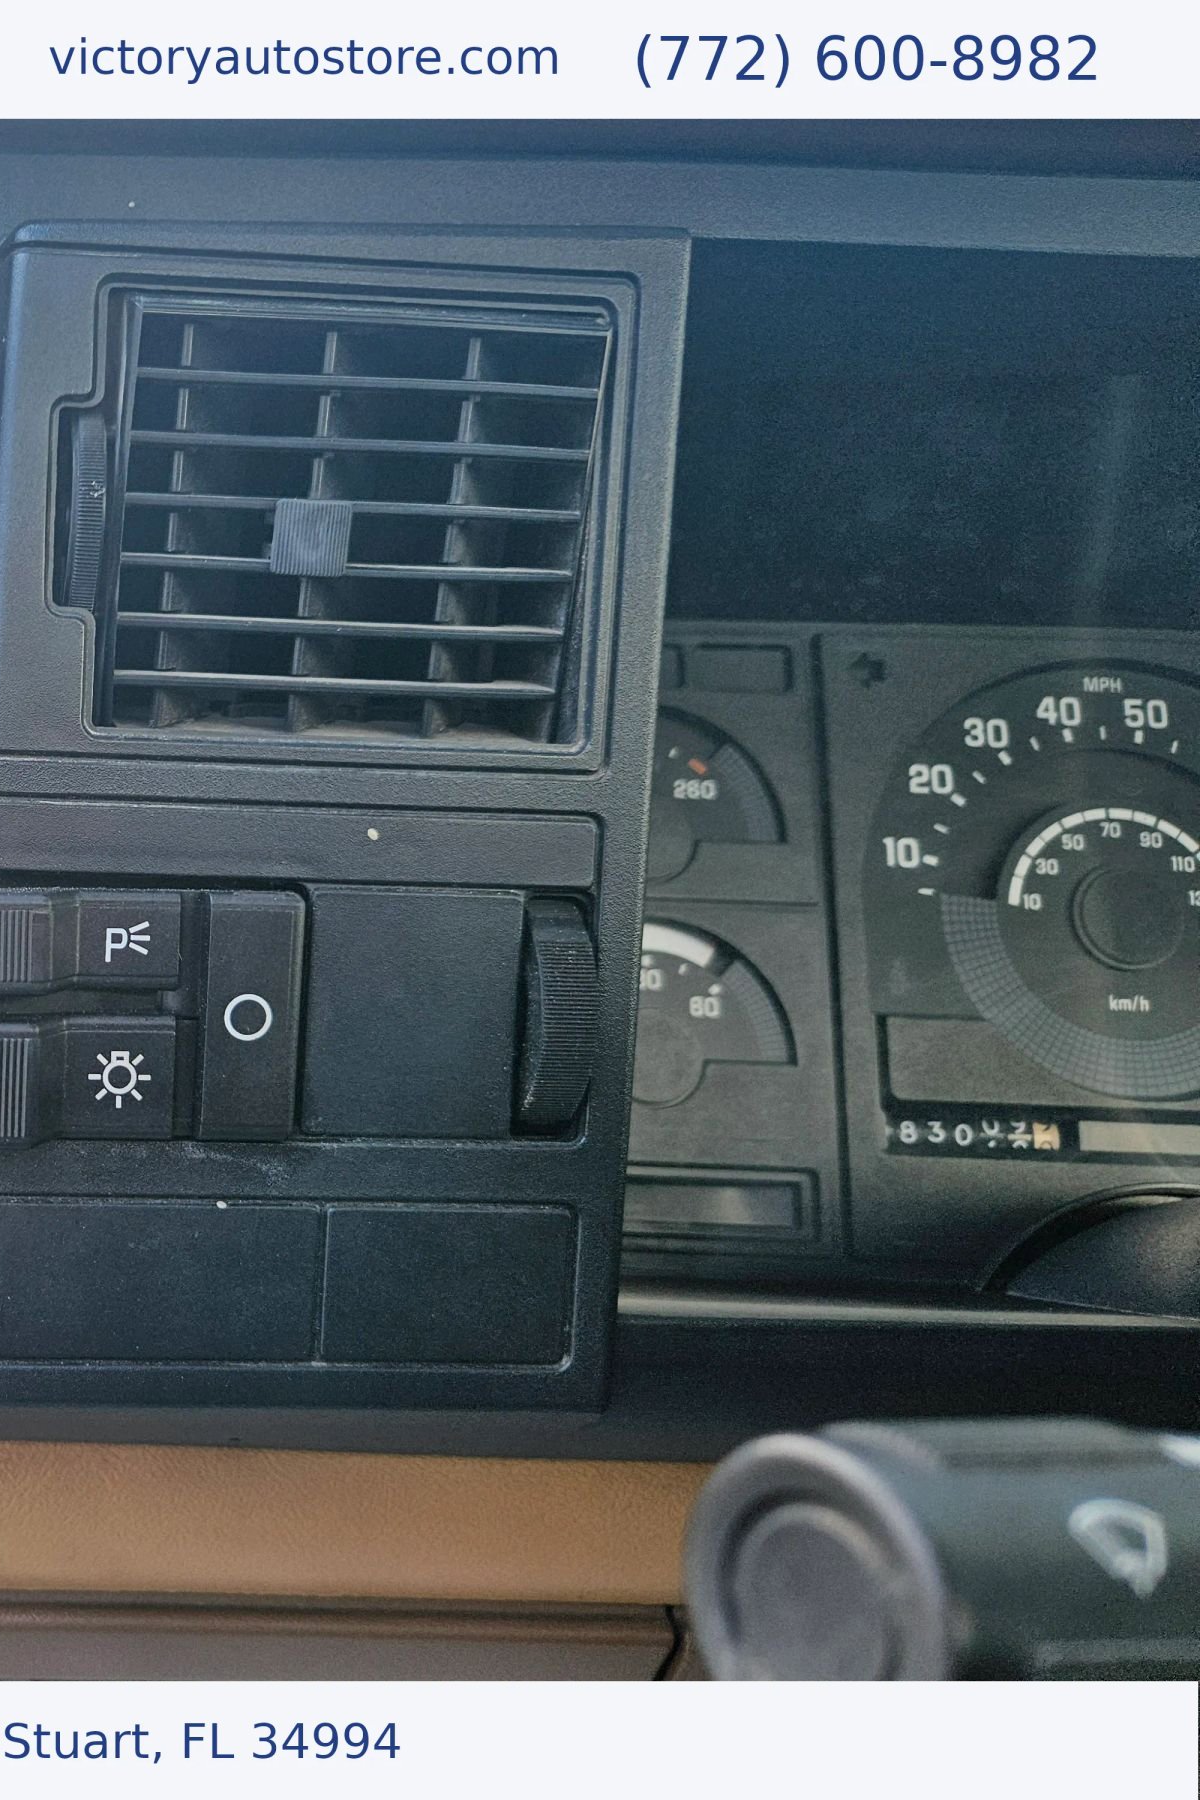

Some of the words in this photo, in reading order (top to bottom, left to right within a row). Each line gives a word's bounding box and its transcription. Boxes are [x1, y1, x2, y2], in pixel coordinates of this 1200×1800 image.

[1083, 676, 1122, 694] MPH
[1036, 696, 1081, 727] 40
[1123, 698, 1168, 729] 50
[963, 717, 1008, 748] 30
[908, 763, 954, 794] 20
[1100, 822, 1121, 838] 70
[1061, 833, 1084, 850] 50
[1139, 831, 1162, 848] 90
[882, 836, 920, 868] 10
[1035, 858, 1059, 875] 30
[1170, 855, 1196, 873] 110
[1022, 893, 1042, 911] 10
[1108, 994, 1150, 1012] km/h
